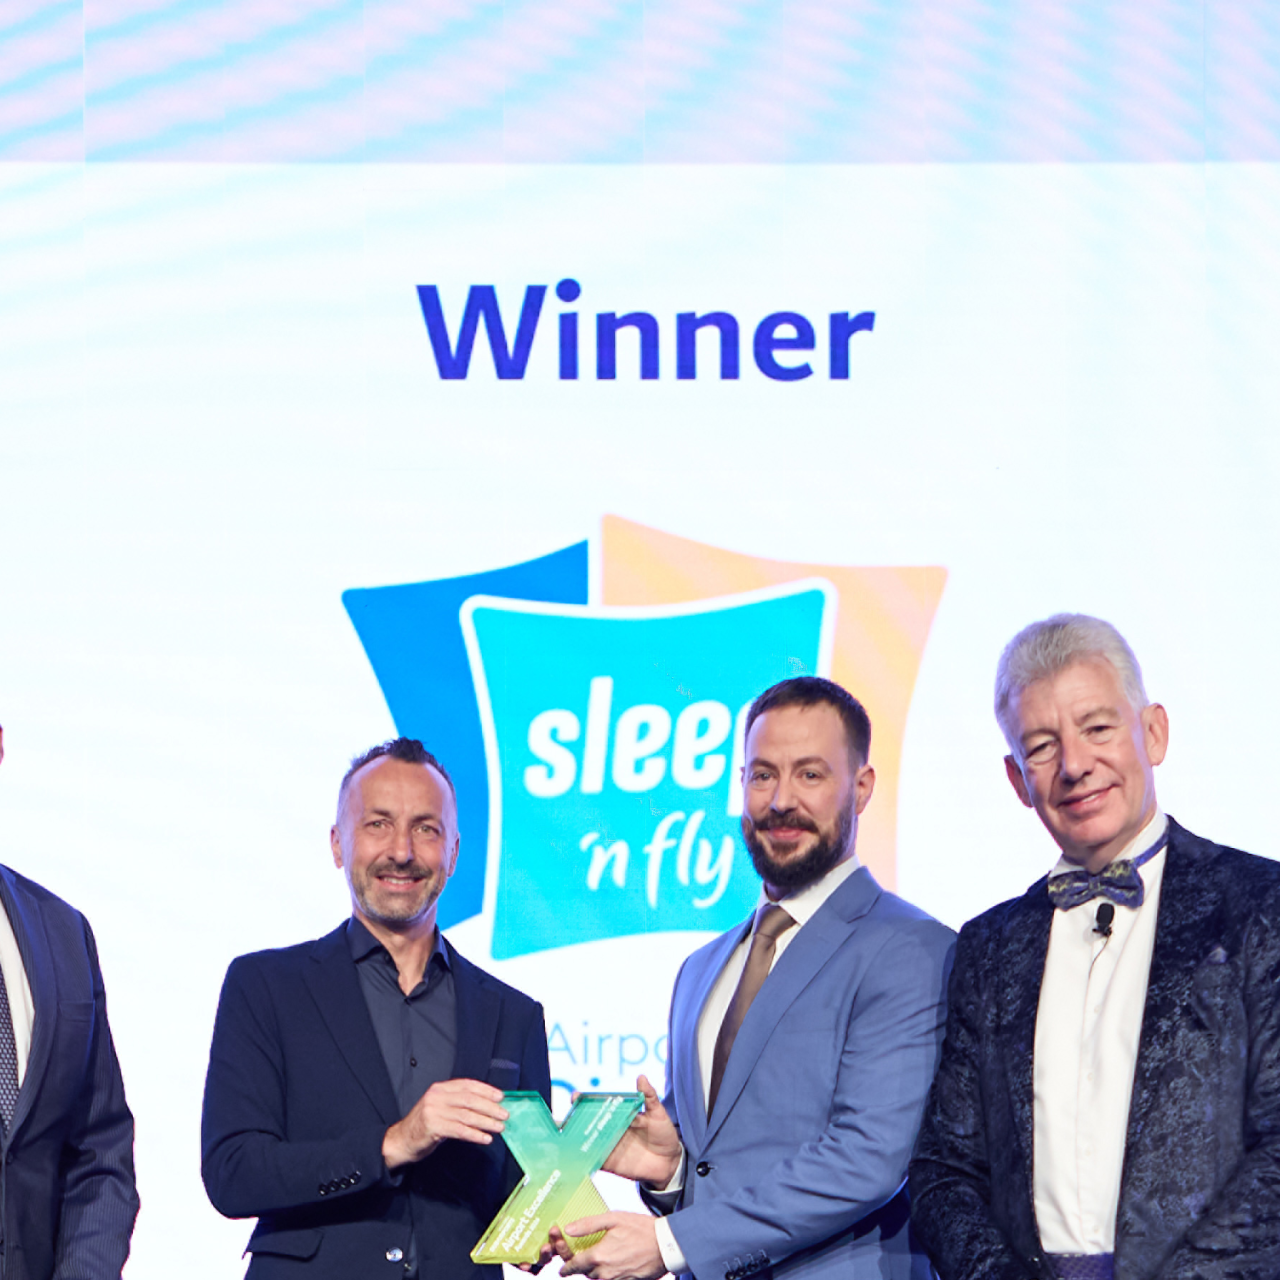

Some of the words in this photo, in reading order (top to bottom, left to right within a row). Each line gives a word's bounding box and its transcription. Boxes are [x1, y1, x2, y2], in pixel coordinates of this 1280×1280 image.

[415, 278, 877, 382] Winner
[642, 809, 735, 909] fly
[502, 1216, 529, 1253] Airport
[523, 1169, 562, 1219] Excellence
